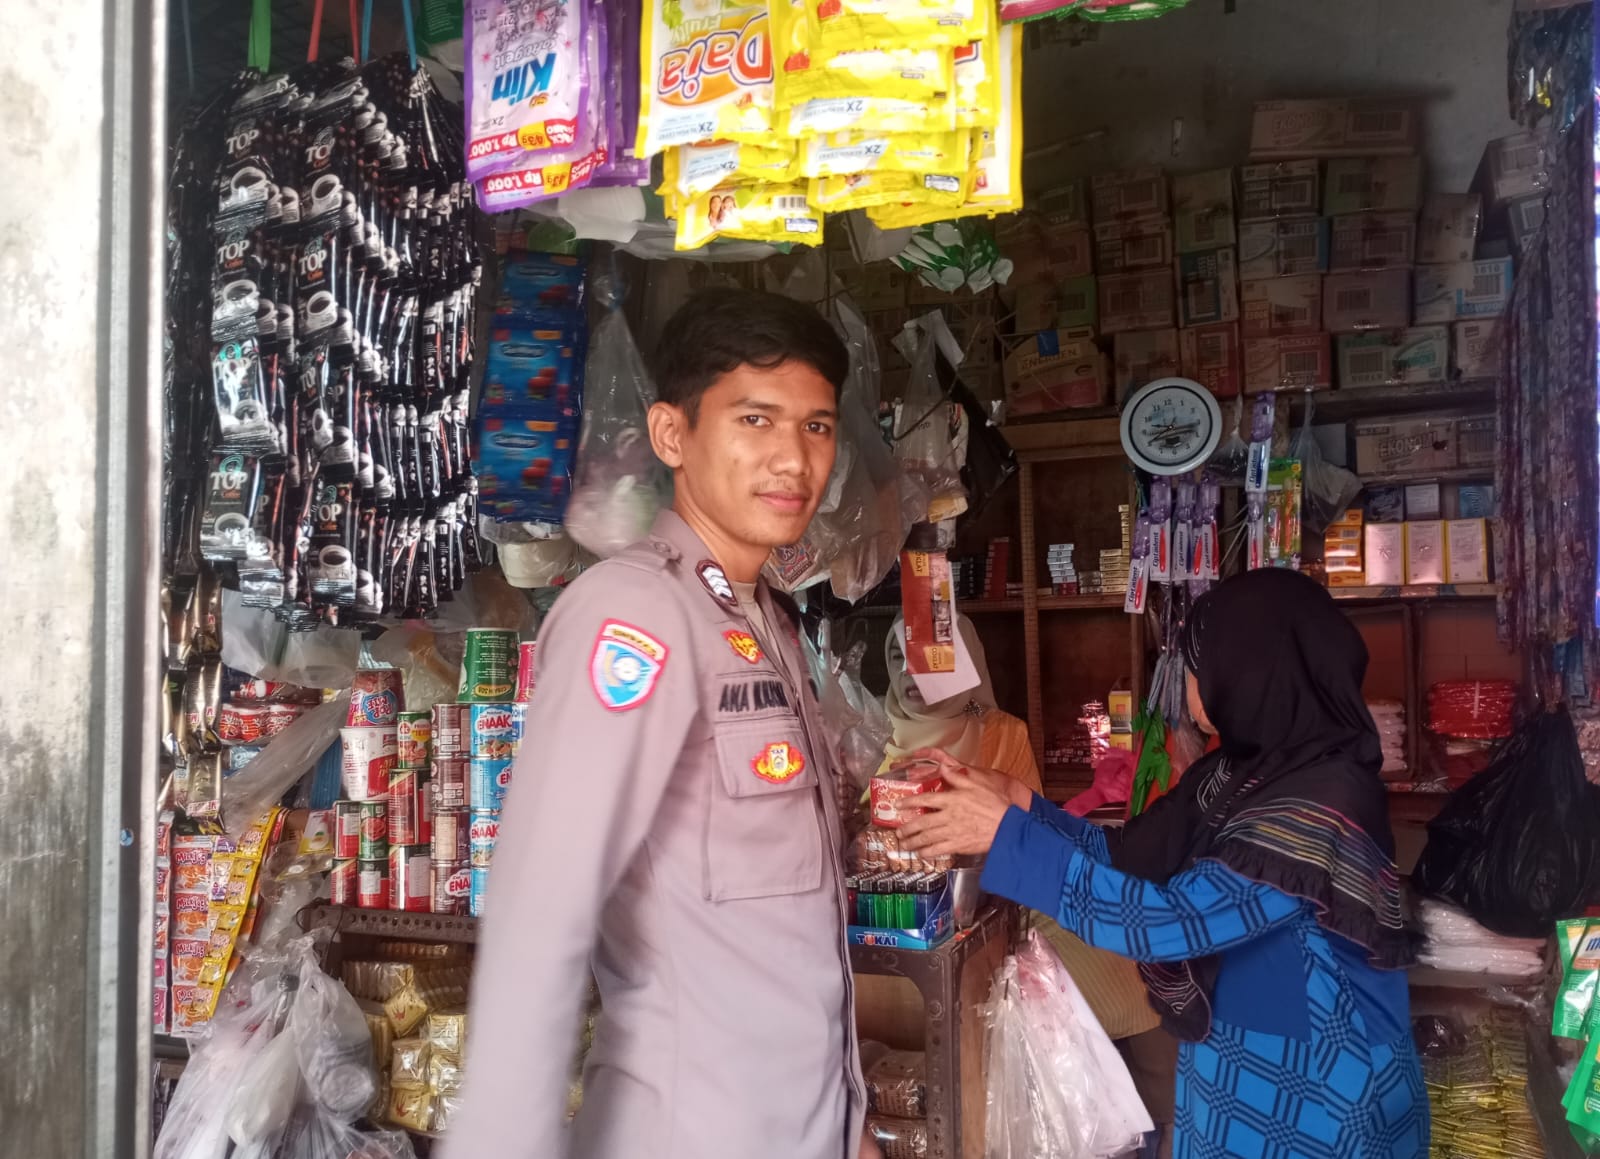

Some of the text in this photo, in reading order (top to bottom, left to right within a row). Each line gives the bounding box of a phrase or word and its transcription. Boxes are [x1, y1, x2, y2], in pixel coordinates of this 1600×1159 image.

[659, 14, 774, 98] Daia
[491, 53, 557, 106] Klin
[226, 129, 260, 155] TOP
[502, 134, 517, 148] Rp
[217, 240, 250, 264] TOP
[299, 249, 328, 275] TOP
[211, 471, 249, 491] TOP
[477, 714, 513, 731] ENAAK
[449, 877, 471, 893] ENA
[856, 933, 898, 949] TOKAI
